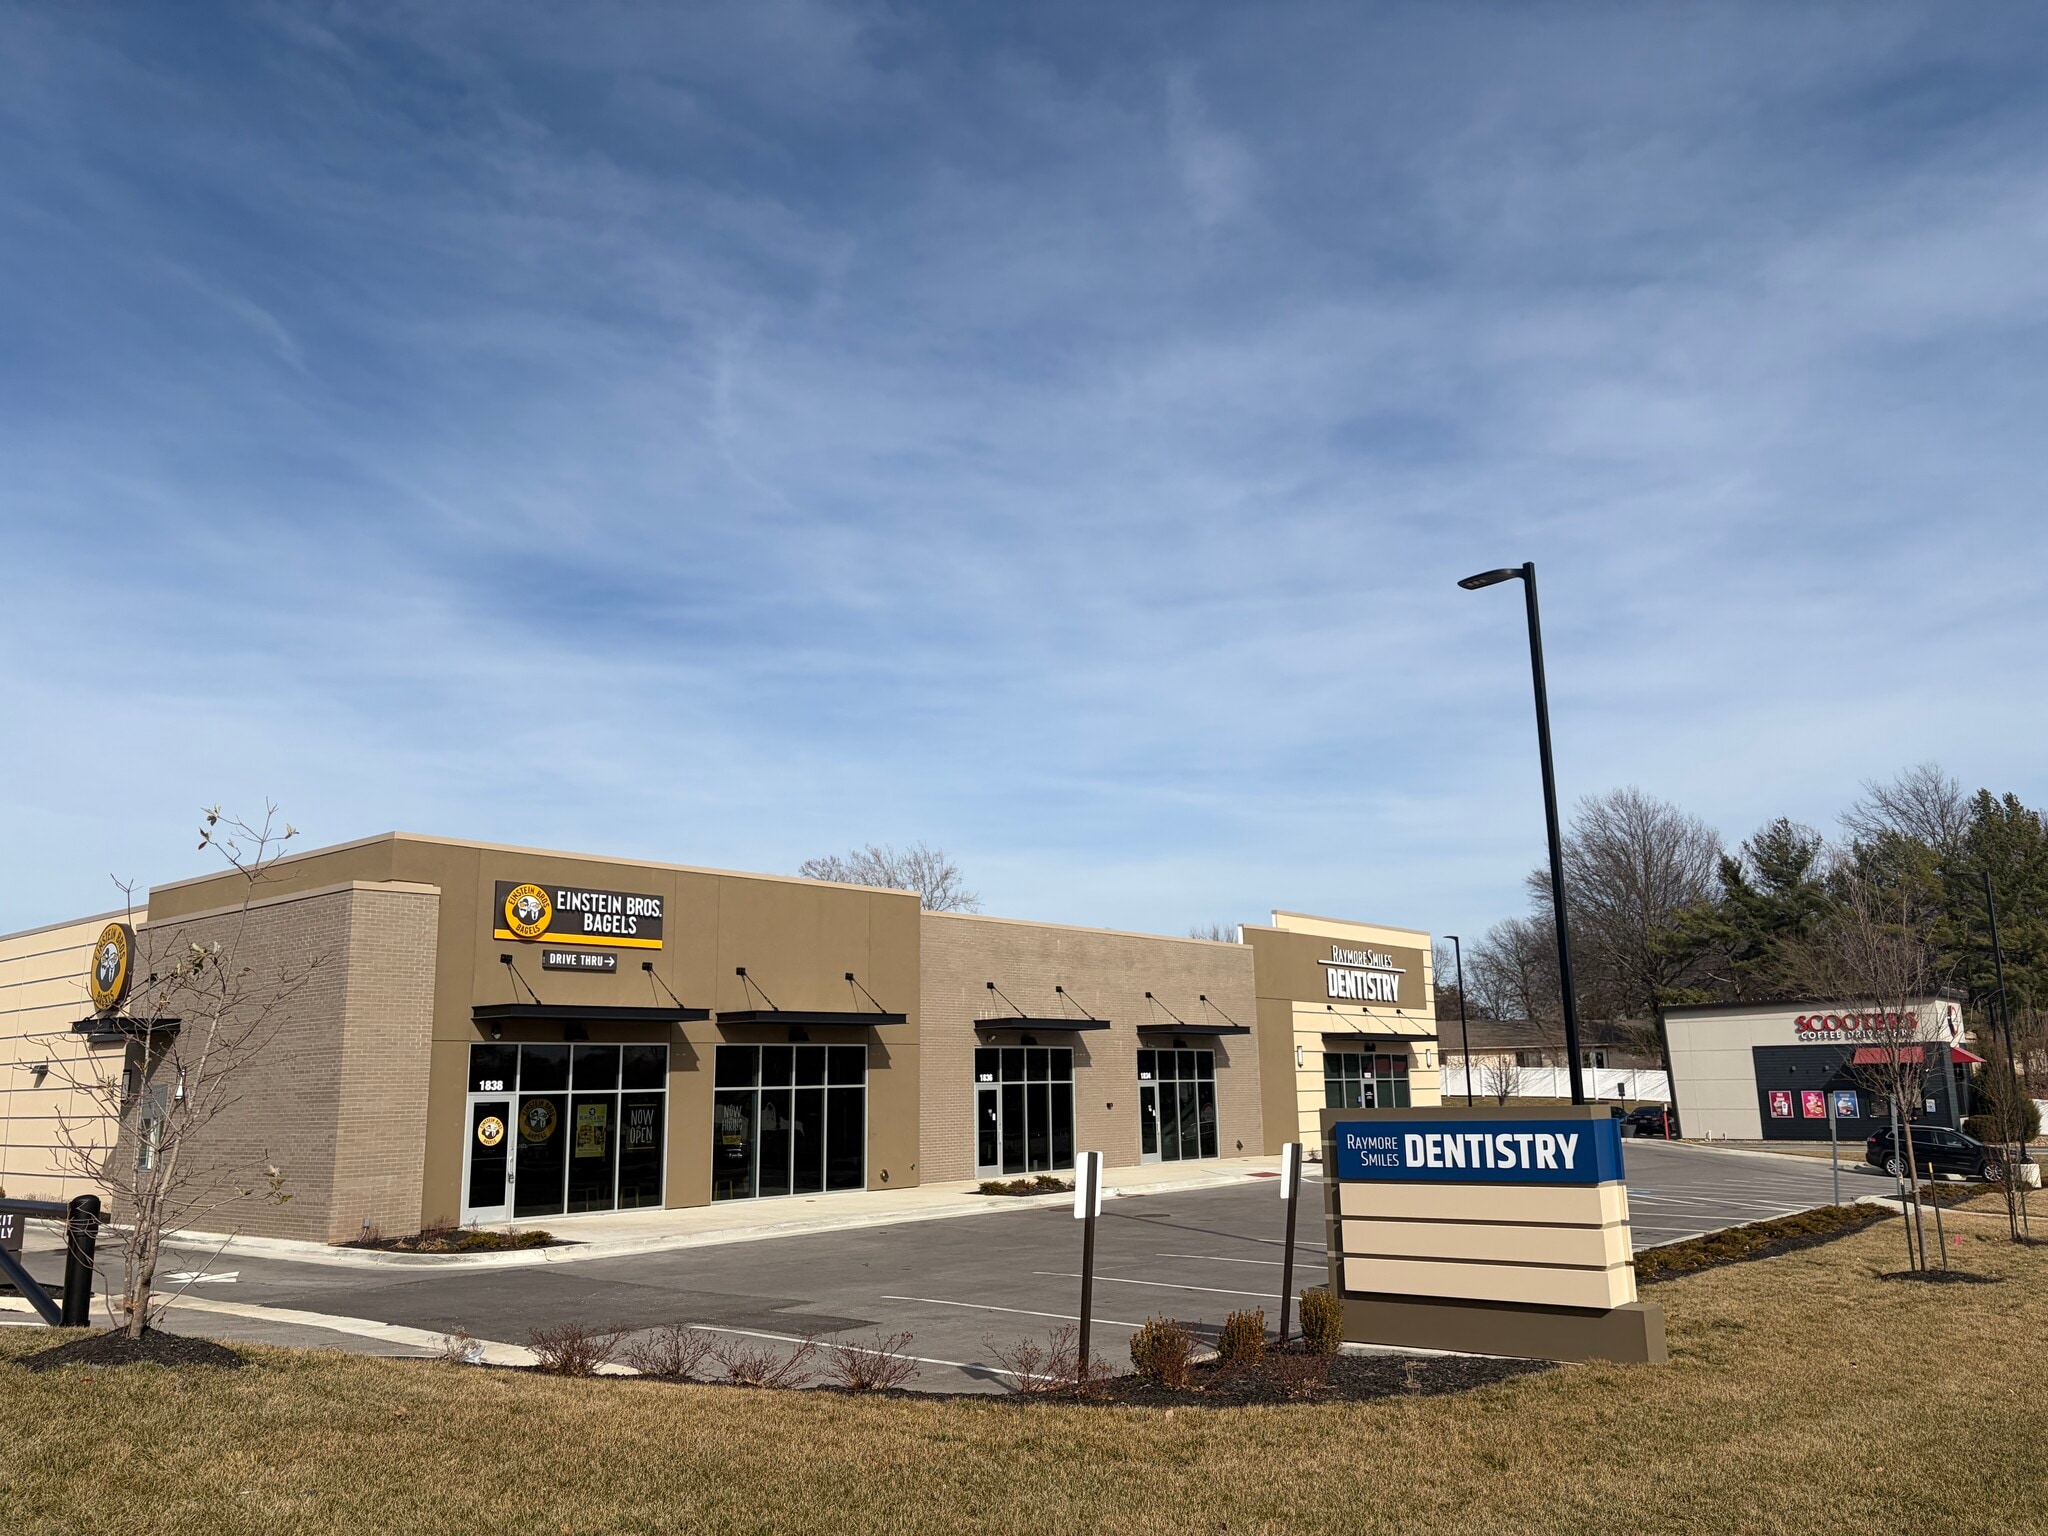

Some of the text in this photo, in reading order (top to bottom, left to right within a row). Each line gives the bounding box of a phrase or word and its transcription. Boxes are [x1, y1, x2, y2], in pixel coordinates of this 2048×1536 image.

[508, 886, 550, 908] EINSTEIN BROS
[557, 890, 662, 918] EINSTEIN BROS.
[515, 924, 541, 935] BAGELS
[584, 913, 637, 934] BAGELS
[95, 928, 125, 960] EINSTEIN BROS
[549, 953, 603, 966] DRIVE THRU
[1332, 945, 1393, 968] RAYMORE SMILES
[1327, 968, 1399, 1002] DENTISTRY
[1801, 1030, 1841, 1040] COFFEE
[479, 1080, 503, 1091] 1838
[631, 1109, 655, 1126] NOW
[723, 1104, 743, 1119] NOW
[630, 1126, 653, 1144] OPEN
[1347, 1133, 1579, 1170] RAYMORE DENTISTRY
[1361, 1150, 1400, 1167] SMILES
[1, 1228, 14, 1239] LY
